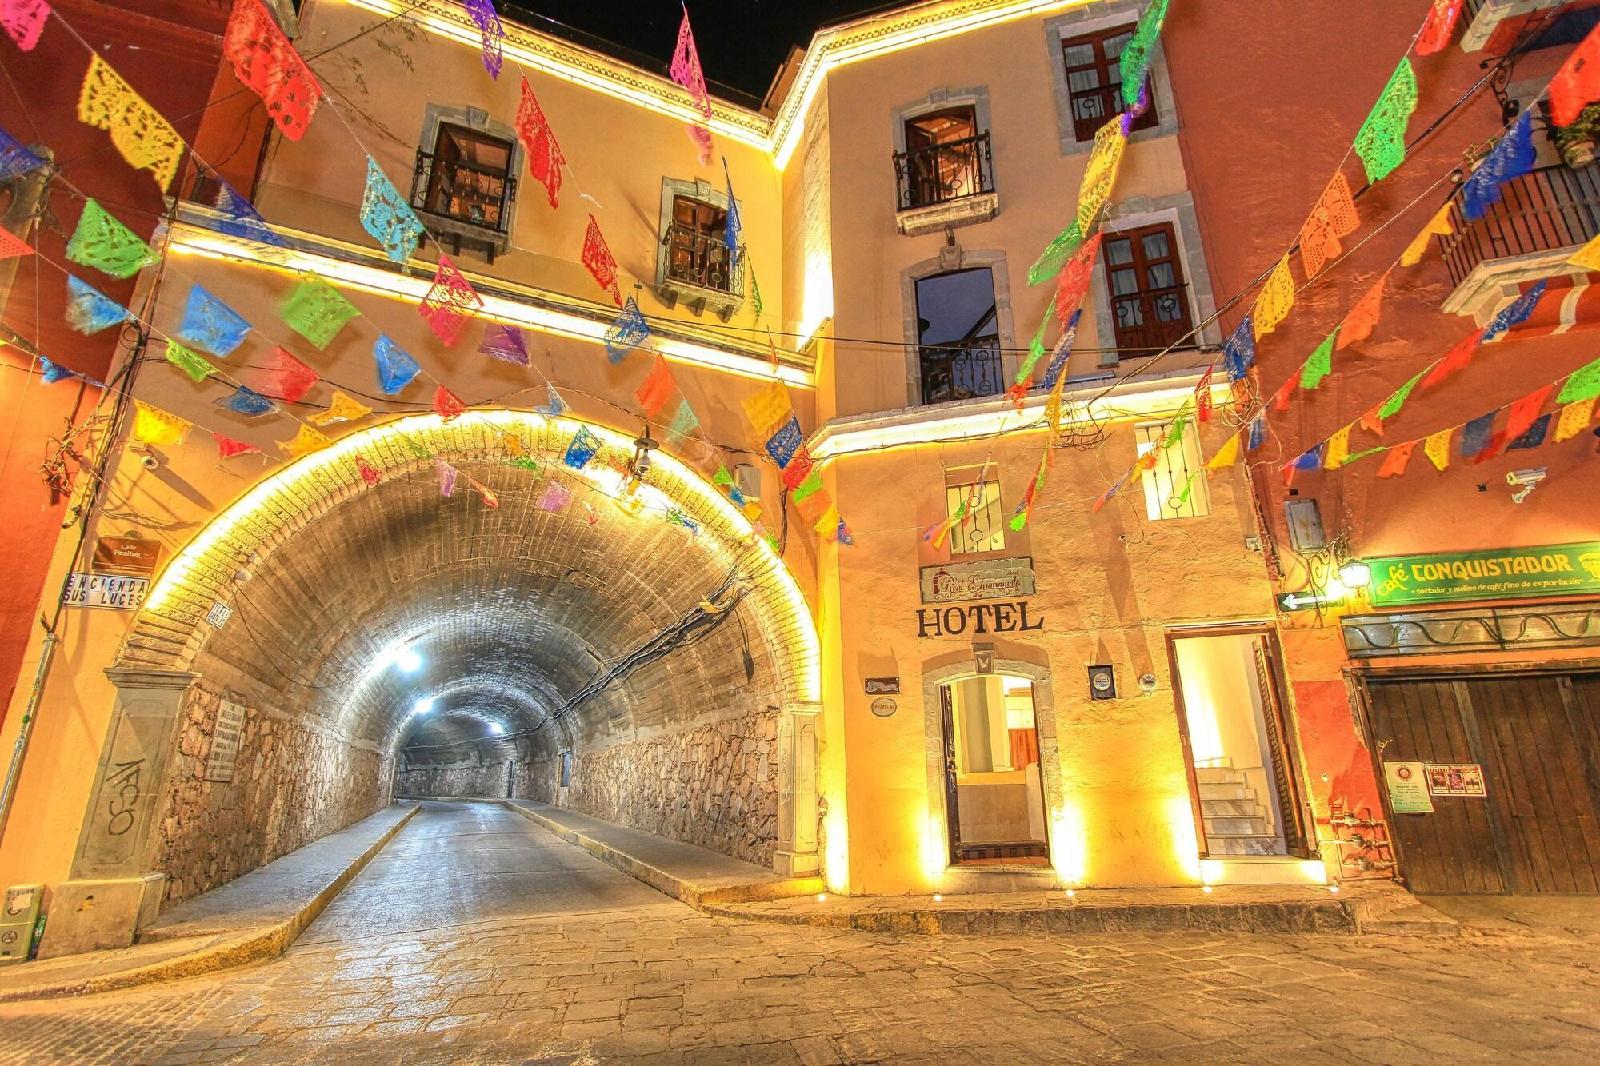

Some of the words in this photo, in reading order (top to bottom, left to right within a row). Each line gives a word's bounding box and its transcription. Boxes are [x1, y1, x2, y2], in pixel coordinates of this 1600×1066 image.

[1411, 554, 1574, 581] CONQUISTADOR
[65, 573, 145, 593] ENCIENDA
[1501, 582, 1520, 592] fino
[1521, 580, 1531, 588] de
[63, 589, 86, 602] SUS
[101, 592, 142, 606] LUCES
[916, 601, 1044, 637] HOTEL
